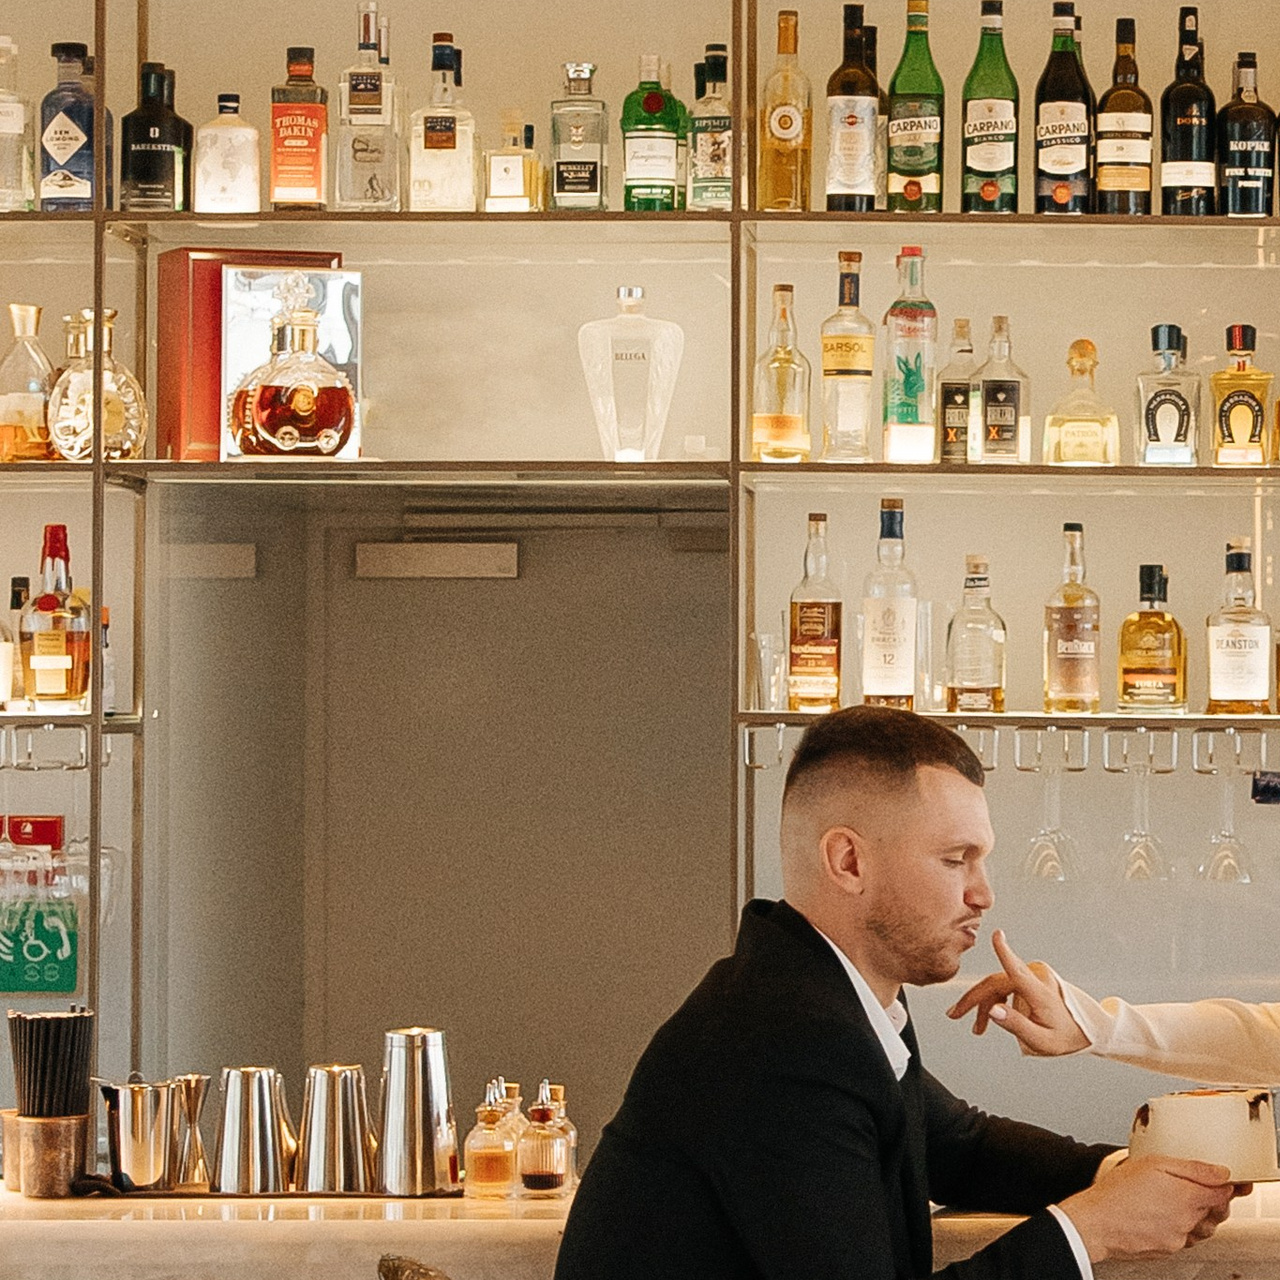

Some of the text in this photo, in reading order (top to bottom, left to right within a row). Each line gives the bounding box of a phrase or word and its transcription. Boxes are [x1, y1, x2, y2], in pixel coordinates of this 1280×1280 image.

[275, 115, 319, 129] THOMAS
[890, 119, 940, 134] CARPANO
[966, 120, 1015, 135] CARPANO
[279, 126, 314, 138] DAKIN
[1038, 122, 1088, 138] CARPANO
[974, 135, 1005, 143] BIANCO
[1042, 137, 1081, 147] CLASSICO
[1230, 140, 1270, 151] KOPKE
[823, 342, 867, 354] BARSOL
[1215, 639, 1260, 650] DEANSTON
[882, 652, 896, 665] 12
